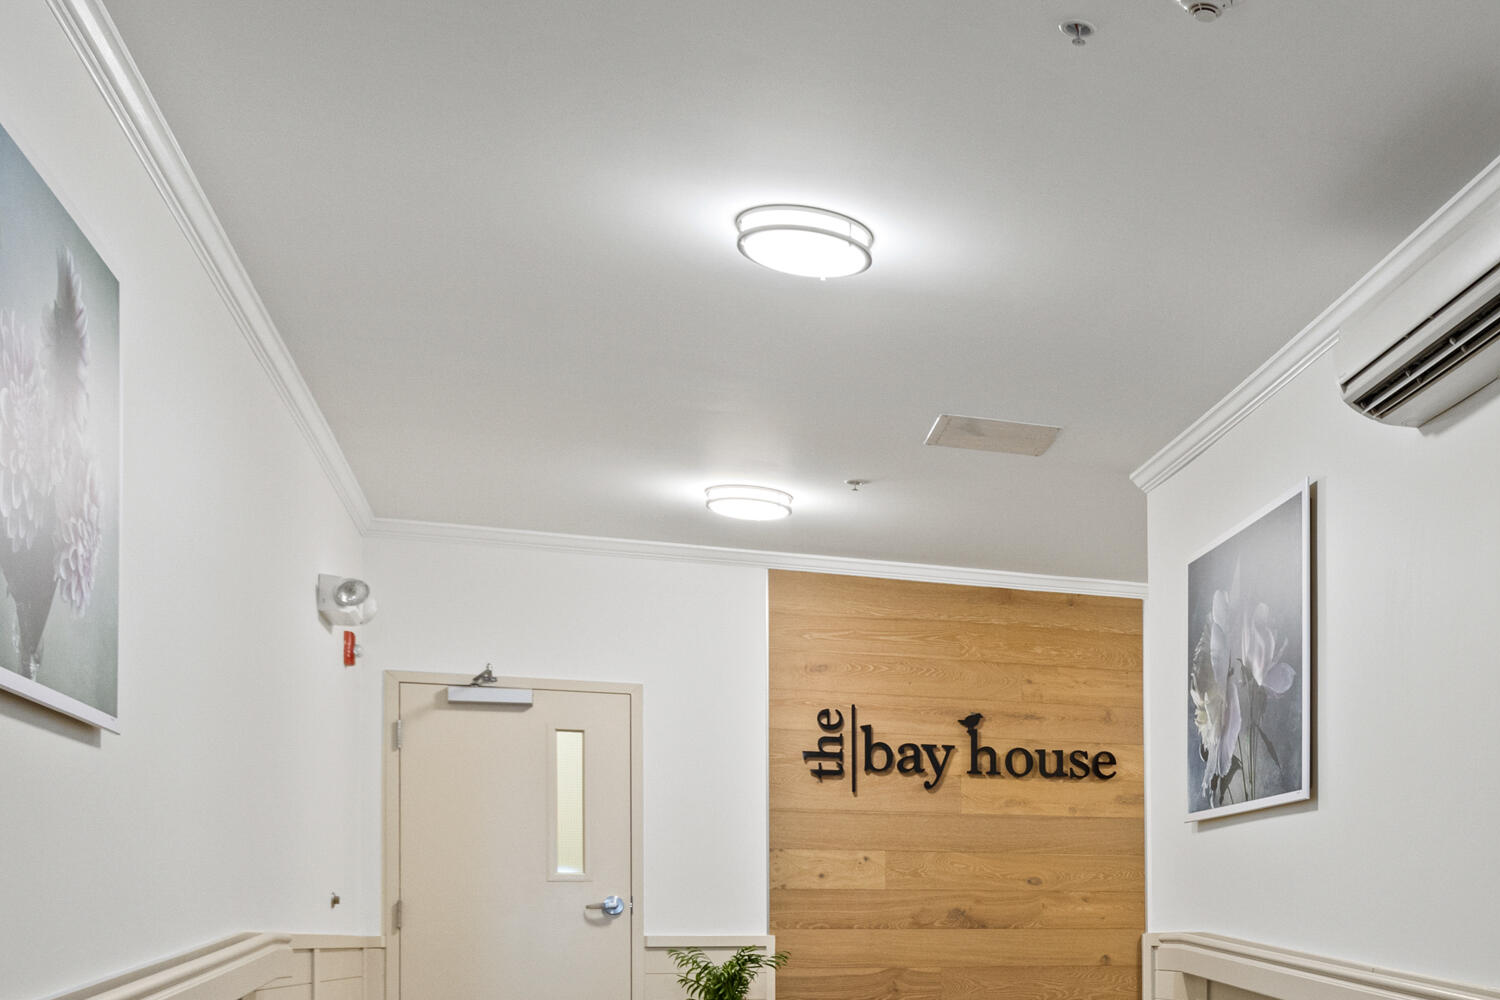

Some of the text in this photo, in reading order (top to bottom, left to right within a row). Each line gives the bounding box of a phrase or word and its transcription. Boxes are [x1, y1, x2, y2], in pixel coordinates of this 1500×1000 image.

[803, 708, 1117, 789] the bay house
